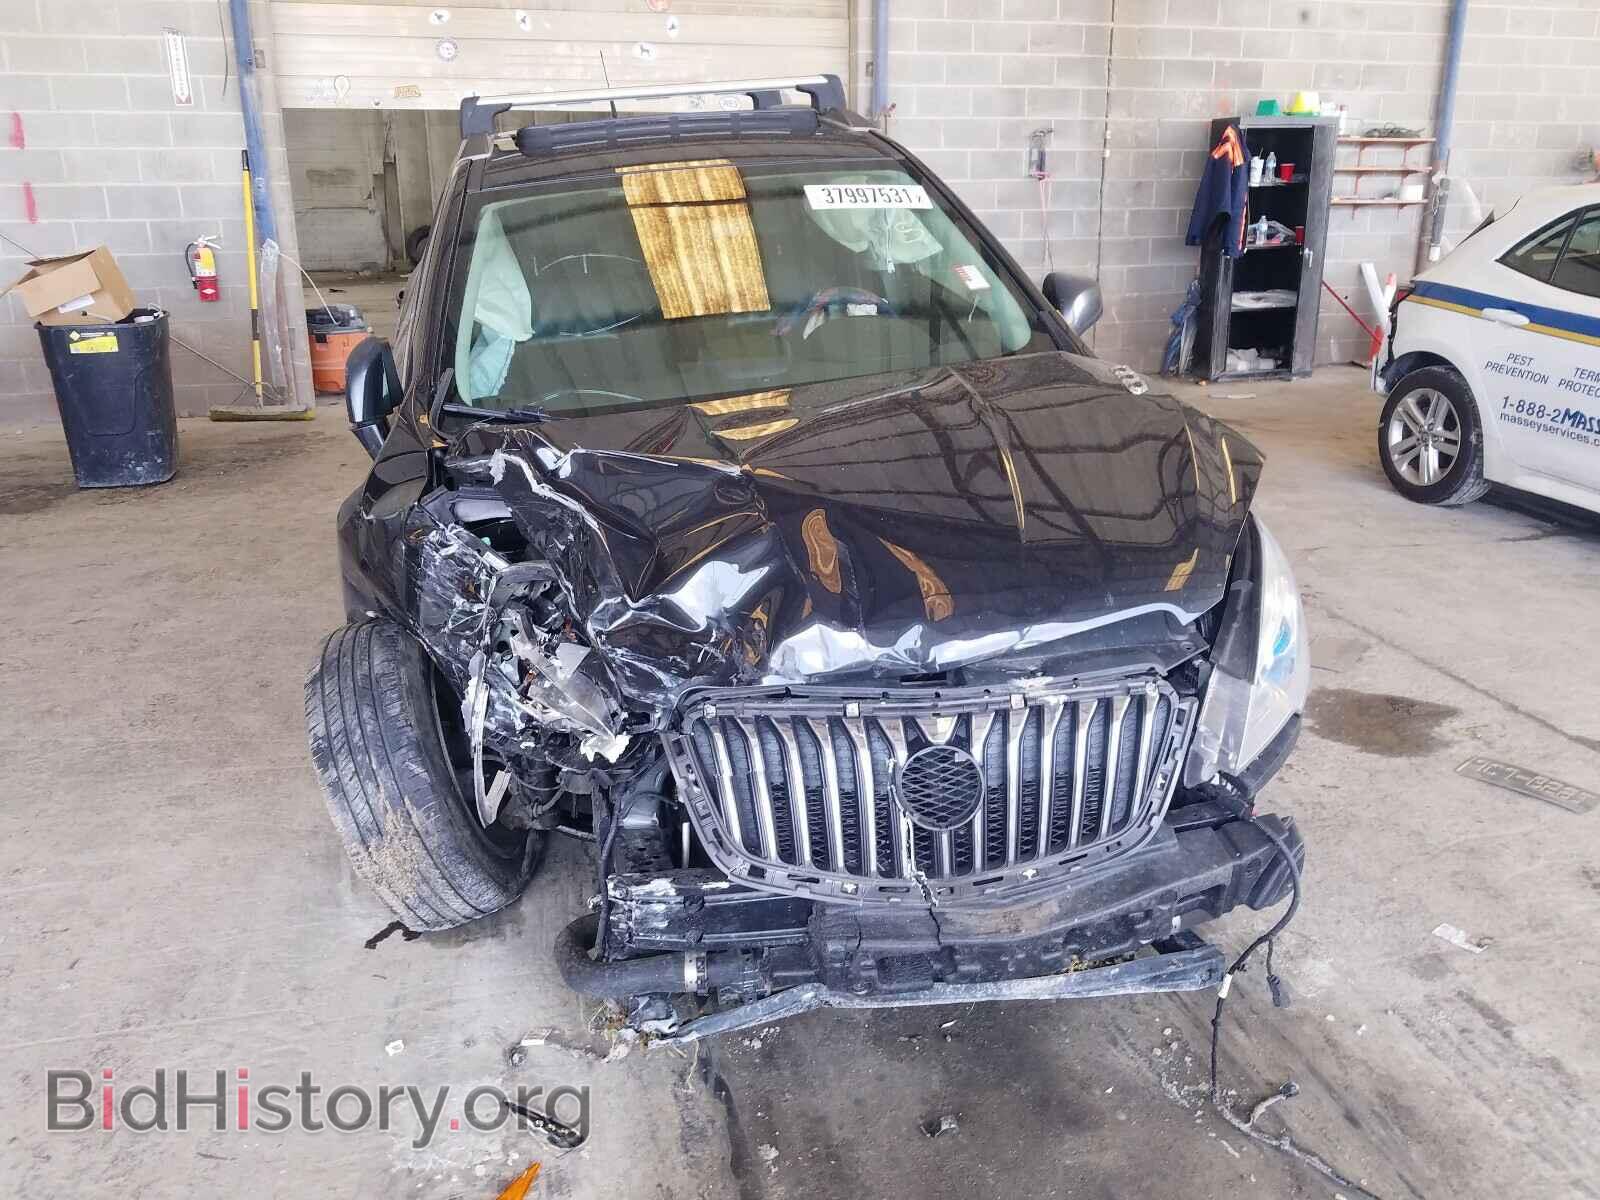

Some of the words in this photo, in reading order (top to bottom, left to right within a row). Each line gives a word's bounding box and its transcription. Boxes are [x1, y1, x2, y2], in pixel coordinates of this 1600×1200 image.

[821, 187, 912, 204] 37997531
[1506, 353, 1534, 367] PEST
[1484, 361, 1549, 385] PREVENTION
